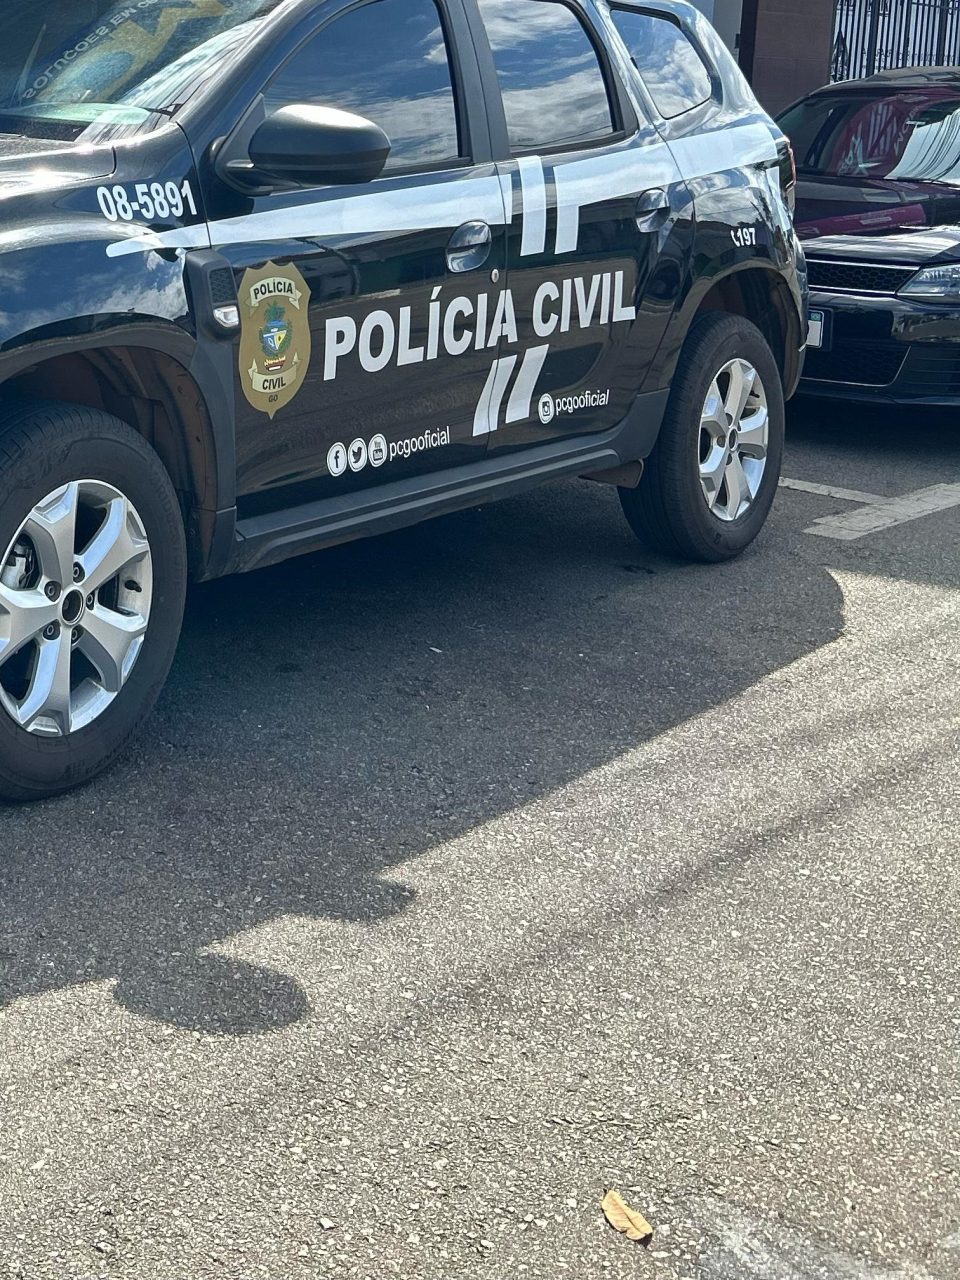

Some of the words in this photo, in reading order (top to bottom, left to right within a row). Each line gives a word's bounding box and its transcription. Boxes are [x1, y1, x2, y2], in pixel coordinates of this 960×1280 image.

[96, 180, 198, 221] 08-5891
[738, 228, 757, 247] 197
[253, 278, 293, 300] POLÍCIA
[323, 285, 518, 381] POLÍCIA
[532, 270, 636, 338] CIVIL
[262, 376, 286, 391] CIVIL
[268, 395, 278, 403] GO
[556, 389, 610, 416] pcgooficial
[389, 425, 450, 461] pcgooficial
